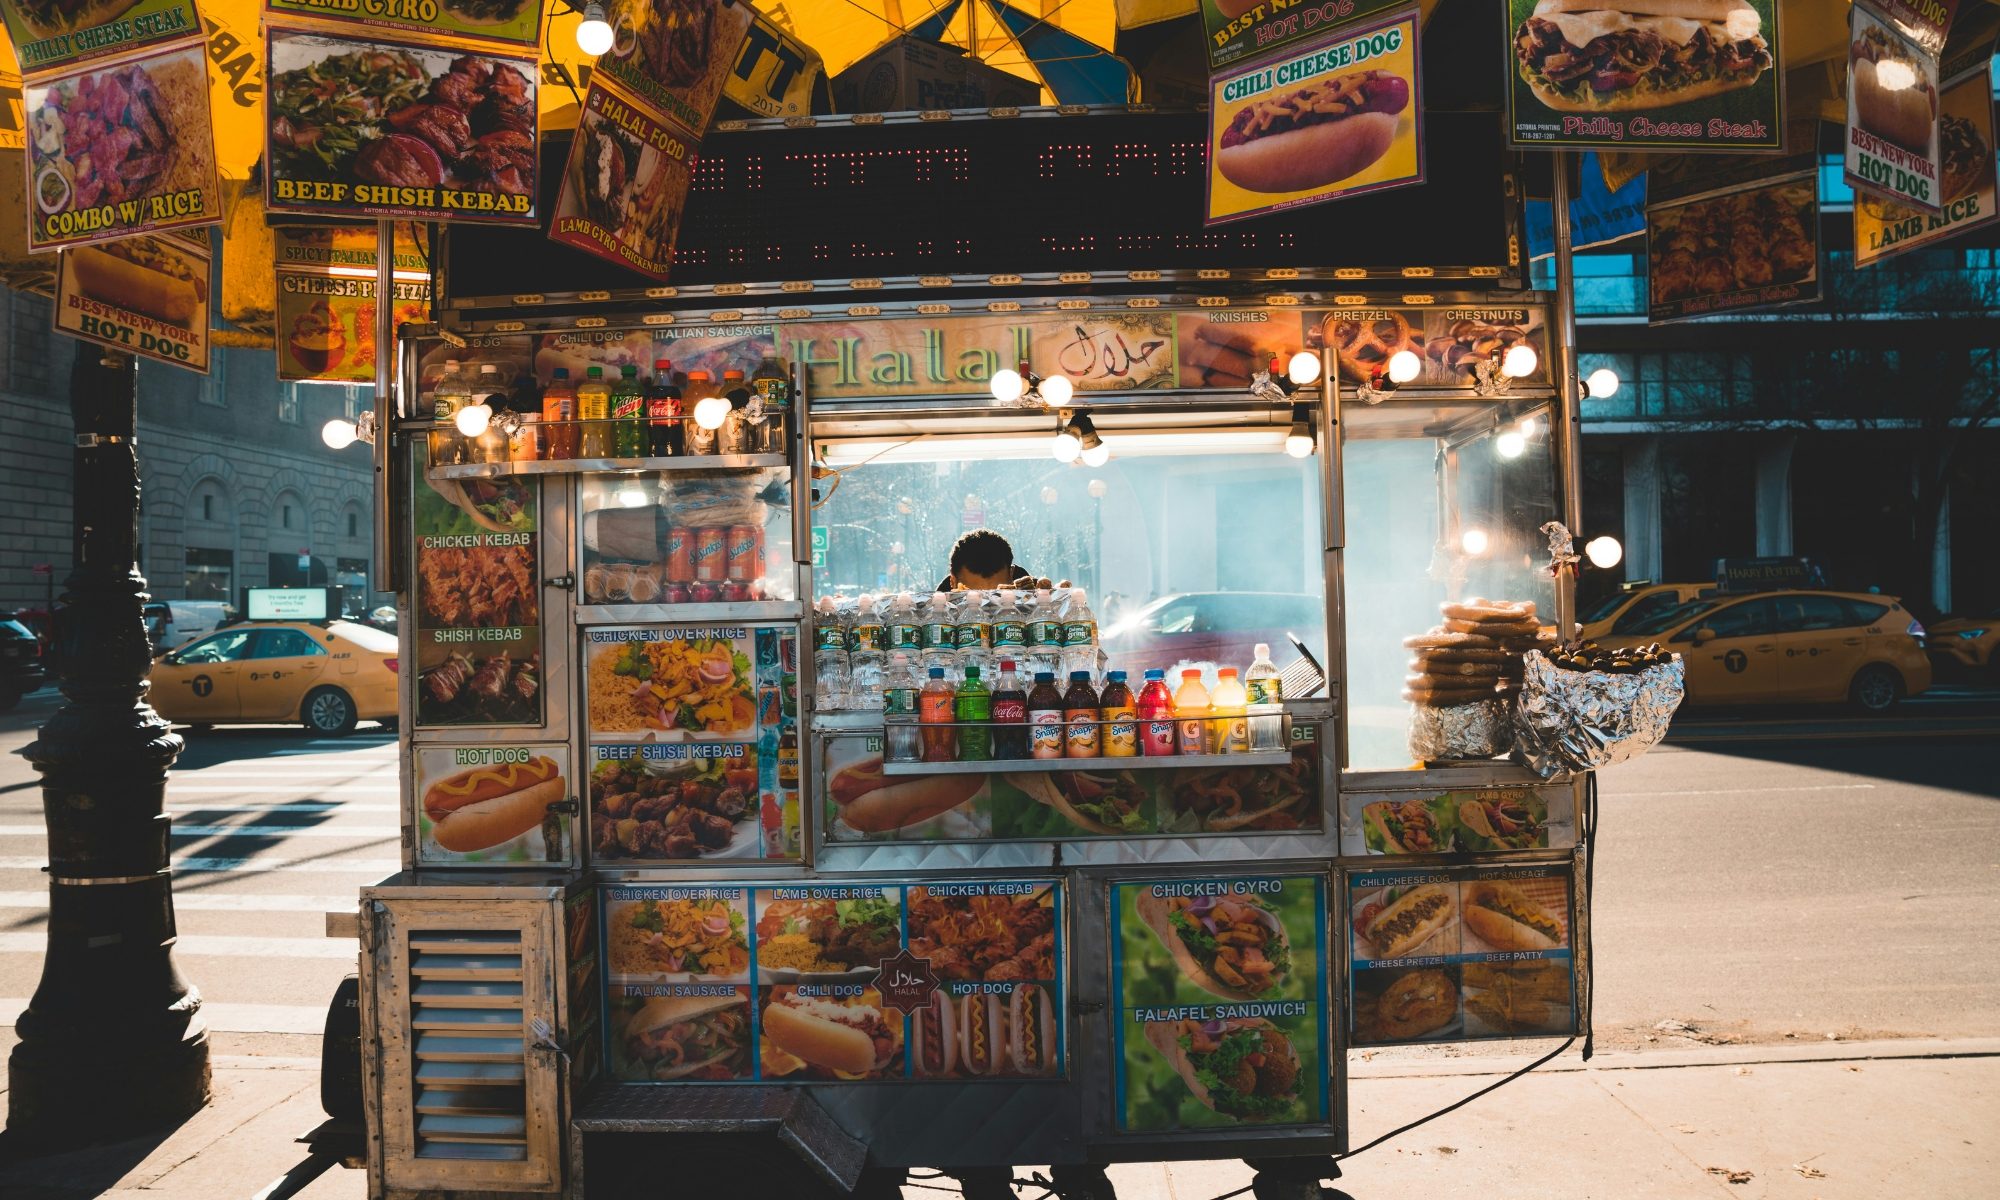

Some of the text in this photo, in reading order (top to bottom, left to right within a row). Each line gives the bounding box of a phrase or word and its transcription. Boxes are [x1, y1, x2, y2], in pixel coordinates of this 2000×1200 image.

[363, 19, 389, 27] ASTORIA
[390, 22, 417, 31] PRINTING
[1213, 4, 1266, 48] BEST
[1255, 14, 1298, 47] HOT
[1302, 0, 1355, 29] DOG
[22, 8, 188, 64] PHILLY CHEESE STEAK
[1223, 28, 1402, 102] CHILI CHEESE DOG
[753, 94, 783, 116] 2017
[601, 96, 647, 139] HALAL
[649, 127, 685, 160] FOOD
[1563, 116, 1767, 141] Philly Cheese Steak
[1851, 127, 1935, 180] BEST NEW YORK
[1858, 152, 1892, 188] HOT
[1895, 168, 1930, 201] DOG
[276, 179, 531, 213] BEEF SHISH KEBAB
[46, 188, 203, 236] COMBO W/ RICE
[1870, 215, 1923, 251] LAMB
[561, 218, 591, 234] LAMB
[592, 225, 617, 252] GYRO
[620, 245, 653, 271] CHICKEN
[285, 246, 323, 261] SPICY
[326, 247, 378, 264] ITALIAN
[283, 276, 358, 297] CHEESE
[69, 294, 200, 346] BEST NEW YORK
[1211, 311, 1268, 323] KNISHES
[1334, 310, 1392, 321] PRETZEL
[1446, 309, 1523, 321] CHESTNUTS
[80, 314, 134, 343] HOT
[140, 331, 190, 360] DOG
[559, 331, 624, 345] CHILI DOG
[655, 325, 771, 339] ITALIAN SAUSAGE
[473, 337, 501, 348] DOG
[789, 326, 1032, 386] Halal
[1058, 324, 1164, 379] حلال
[423, 533, 531, 549] CHICKEN KEBAB
[1728, 566, 1802, 579] HARRY POTTER
[434, 628, 522, 643] SHISH KEBAB
[592, 627, 746, 642] CHICKEN OVER RICE
[456, 748, 529, 764] HOT DOG
[599, 745, 744, 760] BEEF SHISH KEBAB
[1476, 791, 1525, 800] LAMB GYRO
[1360, 874, 1450, 888] CHILI CHEESE DOG
[1480, 869, 1547, 880] HOT SAUSAGE
[614, 889, 740, 900] CHICKEN OVER RICE
[773, 888, 882, 900] LAMB OVER RICE
[927, 884, 1033, 897] CHICKEN KEBAB
[1152, 880, 1282, 898] CHICKEN GYRO
[1368, 957, 1446, 969] CHEESE PRETZEL
[1486, 951, 1543, 962] BEEF PATTY
[889, 970, 924, 987] حلال
[624, 985, 736, 997] ITALIAN SAUSAGE
[797, 985, 863, 996] CHILI DOG
[895, 988, 920, 996] HALAL
[952, 983, 1012, 994] HOT DOG
[1135, 1003, 1306, 1022] FALAFEL SANDWICH
